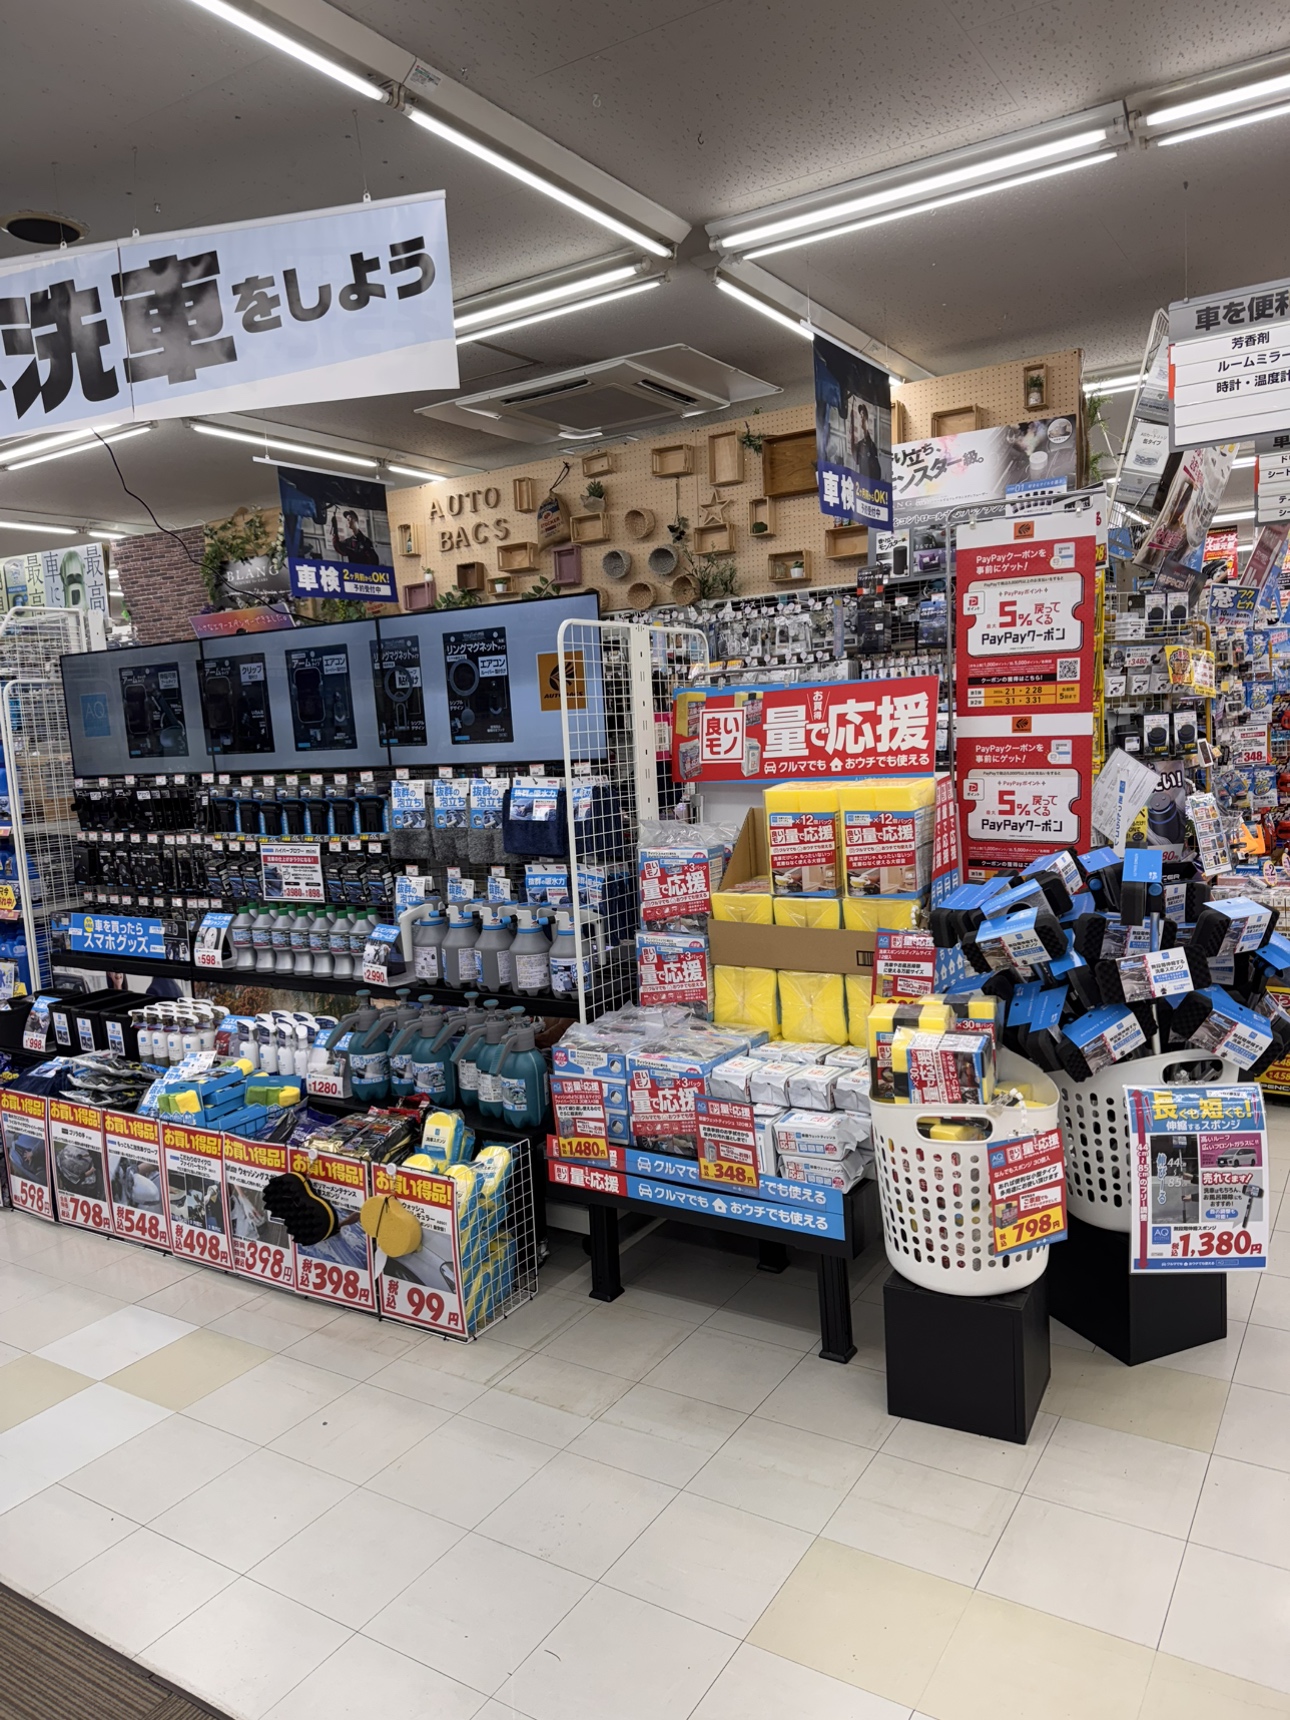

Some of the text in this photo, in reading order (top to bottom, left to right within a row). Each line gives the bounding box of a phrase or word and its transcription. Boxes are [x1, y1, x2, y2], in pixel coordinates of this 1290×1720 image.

[0, 236, 436, 419] 洗車をしよう
[1232, 331, 1270, 350] 芳香剤
[892, 443, 941, 467] り立ち、
[822, 470, 855, 511] 車検
[428, 487, 502, 521] AUTO
[438, 518, 511, 553] BACS
[976, 549, 1046, 565] PayPayクーポンを
[226, 565, 279, 582] BLANG
[976, 562, 1028, 575] 事前にゲット!
[84, 545, 105, 612] 最高
[296, 564, 341, 593] 車検
[353, 583, 382, 594] 予約受付中
[1211, 586, 1237, 609] 窓
[999, 600, 1033, 628] 5%
[1034, 602, 1061, 614] 戻って
[1035, 614, 1053, 625] くる
[981, 627, 1065, 646] PayPayクーポン
[447, 642, 498, 655] リングマグネット
[324, 657, 345, 667] エアコン
[480, 659, 505, 669] エアコン
[85, 701, 106, 720] AQ
[705, 716, 739, 735] 良い
[762, 691, 929, 759] 量で応援
[705, 736, 738, 756] モノ
[975, 744, 1044, 755] PayPayクーポンを
[779, 754, 930, 772] クルマでも おウチでも使える
[975, 755, 1026, 763] 事前にゲット!
[393, 787, 417, 797] 抜群の
[436, 786, 460, 797] 抜群の
[472, 786, 499, 797] 抜群の
[1032, 796, 1058, 806] 戻って
[998, 790, 1031, 816] 5%
[1034, 806, 1051, 816] くる
[785, 825, 834, 843] 量で応援
[862, 824, 914, 843] 量で応援
[981, 819, 1062, 832] PayPayクーポン
[644, 862, 659, 870] 良い
[645, 869, 659, 877] モノ
[642, 871, 708, 901] 量で応援
[94, 919, 144, 934] 車を買ったら
[83, 932, 149, 954] スマホグッズ
[642, 948, 655, 956] 良い
[643, 955, 656, 963] モノ
[640, 960, 704, 986] 量で応援
[634, 1071, 648, 1080] 良い
[635, 1079, 649, 1087] モノ
[1, 1092, 45, 1117] お買い得品!
[50, 1102, 101, 1128] お買い得品!
[104, 1115, 158, 1141] お買い得品!
[1166, 1119, 1241, 1131] 伸縮するスポンジ
[164, 1128, 222, 1156] お買い得品!
[567, 1140, 606, 1156] 1,480円
[1200, 1135, 1230, 1143] 高いルーフ
[224, 1139, 286, 1169] お買い得品!
[713, 1163, 754, 1184] 348円
[994, 1161, 1033, 1178] なんでもスポンジ
[1203, 1172, 1253, 1185] 売れてます!
[570, 1167, 620, 1194] 量で応援
[20, 1181, 50, 1214] 598円
[69, 1199, 111, 1229] 798円
[654, 1186, 828, 1231] クルマでも おウチでも使える
[117, 1206, 124, 1231] 税込
[124, 1209, 167, 1243] 548円
[1012, 1213, 1060, 1243] 798円
[175, 1224, 184, 1251] 税込
[1154, 1228, 1169, 1237] AQ
[183, 1229, 229, 1264] 498円
[1179, 1230, 1262, 1257] 1,380円
[245, 1242, 293, 1282] 398円
[300, 1259, 312, 1287] 税込
[312, 1262, 370, 1302] 398円
[386, 1279, 399, 1309] 税込
[407, 1287, 460, 1327] 99円
